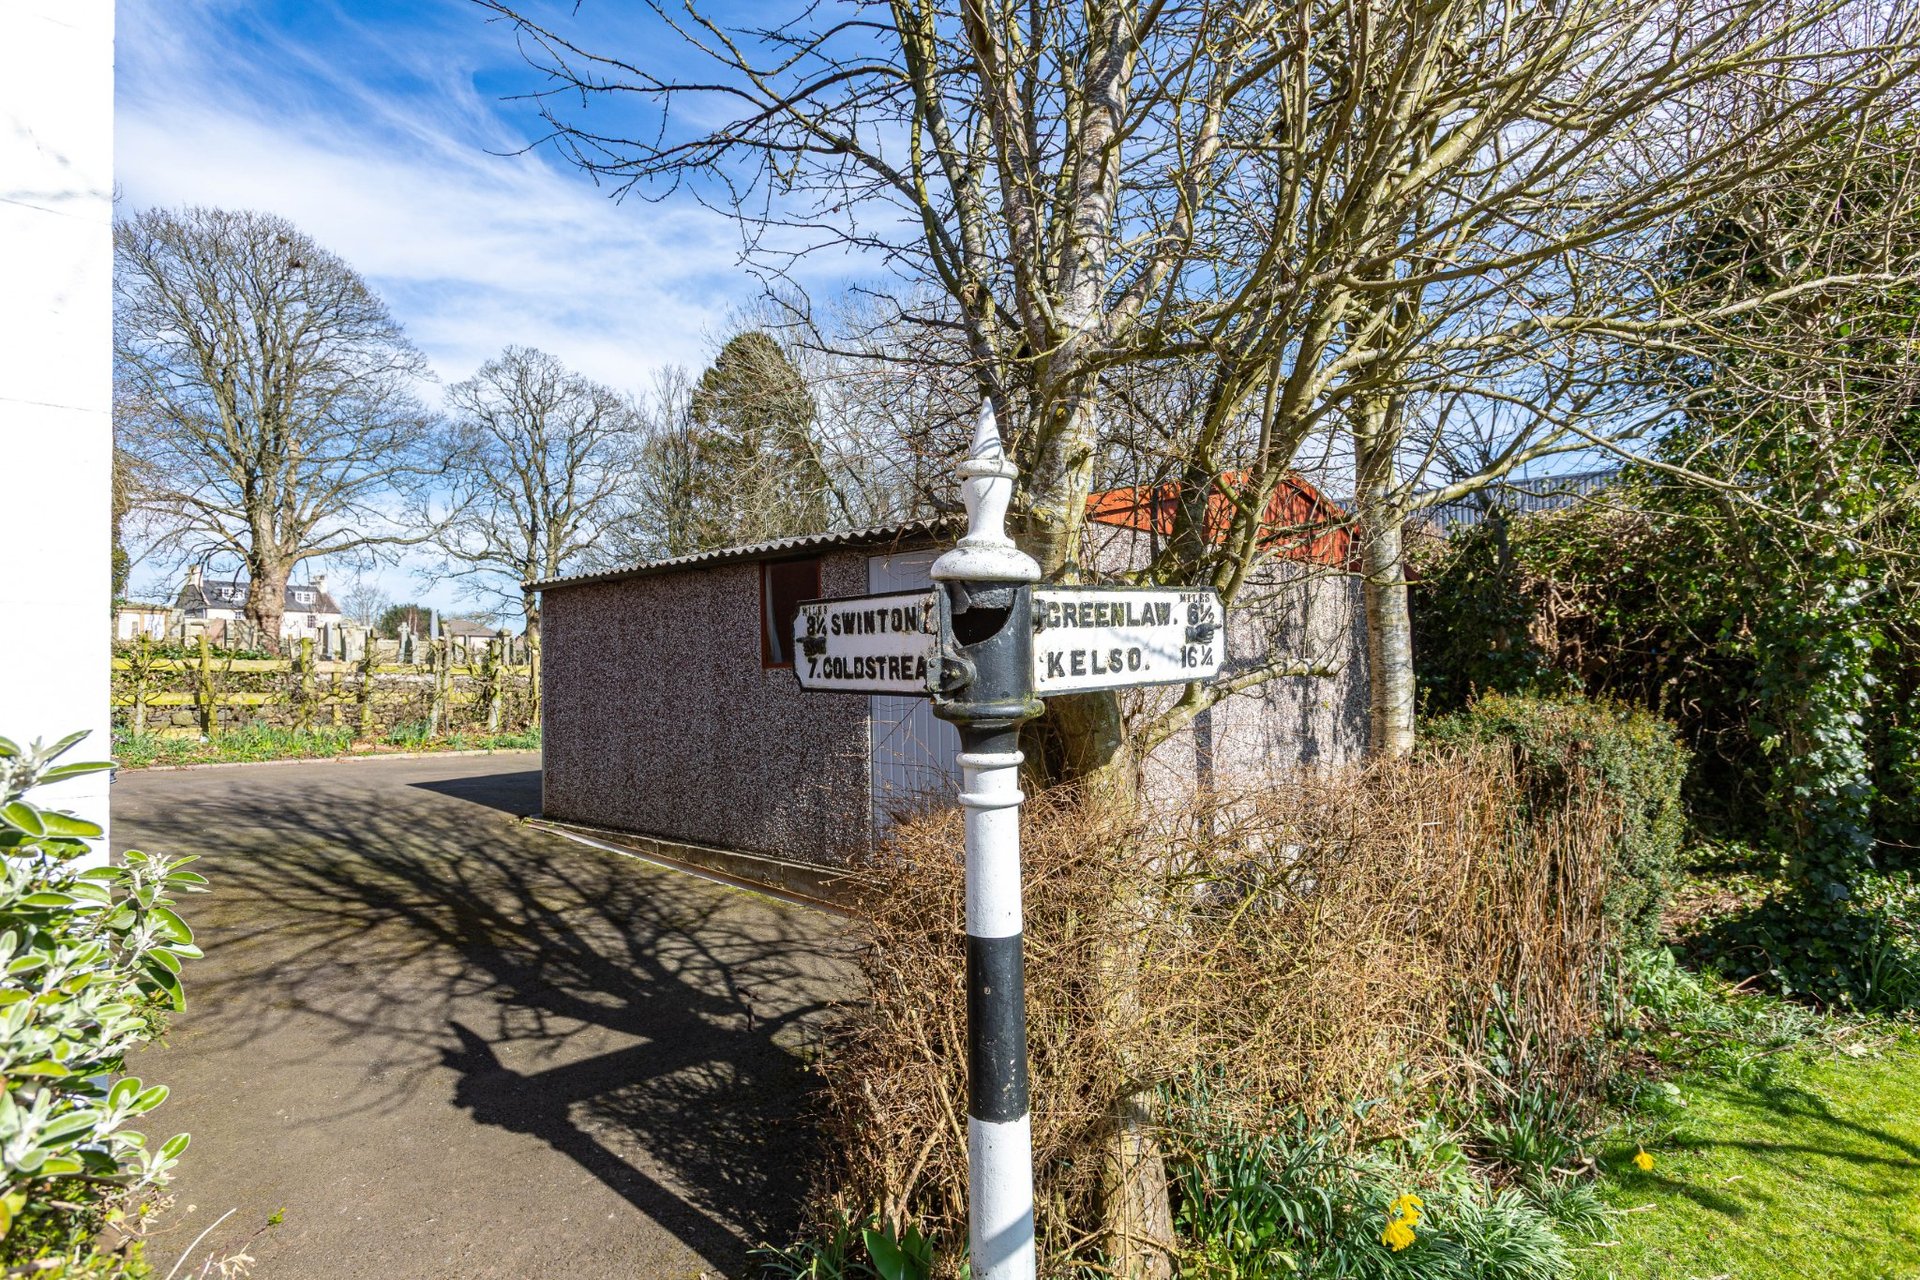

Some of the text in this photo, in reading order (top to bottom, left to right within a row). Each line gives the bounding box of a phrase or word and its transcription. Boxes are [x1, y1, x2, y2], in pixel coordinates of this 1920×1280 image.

[1180, 592, 1211, 603] MILES
[831, 606, 918, 636] SWINTON
[1045, 601, 1178, 629] GREENLAW.
[823, 655, 928, 681] COLDSTREA
[1047, 647, 1150, 679] KELSO.
